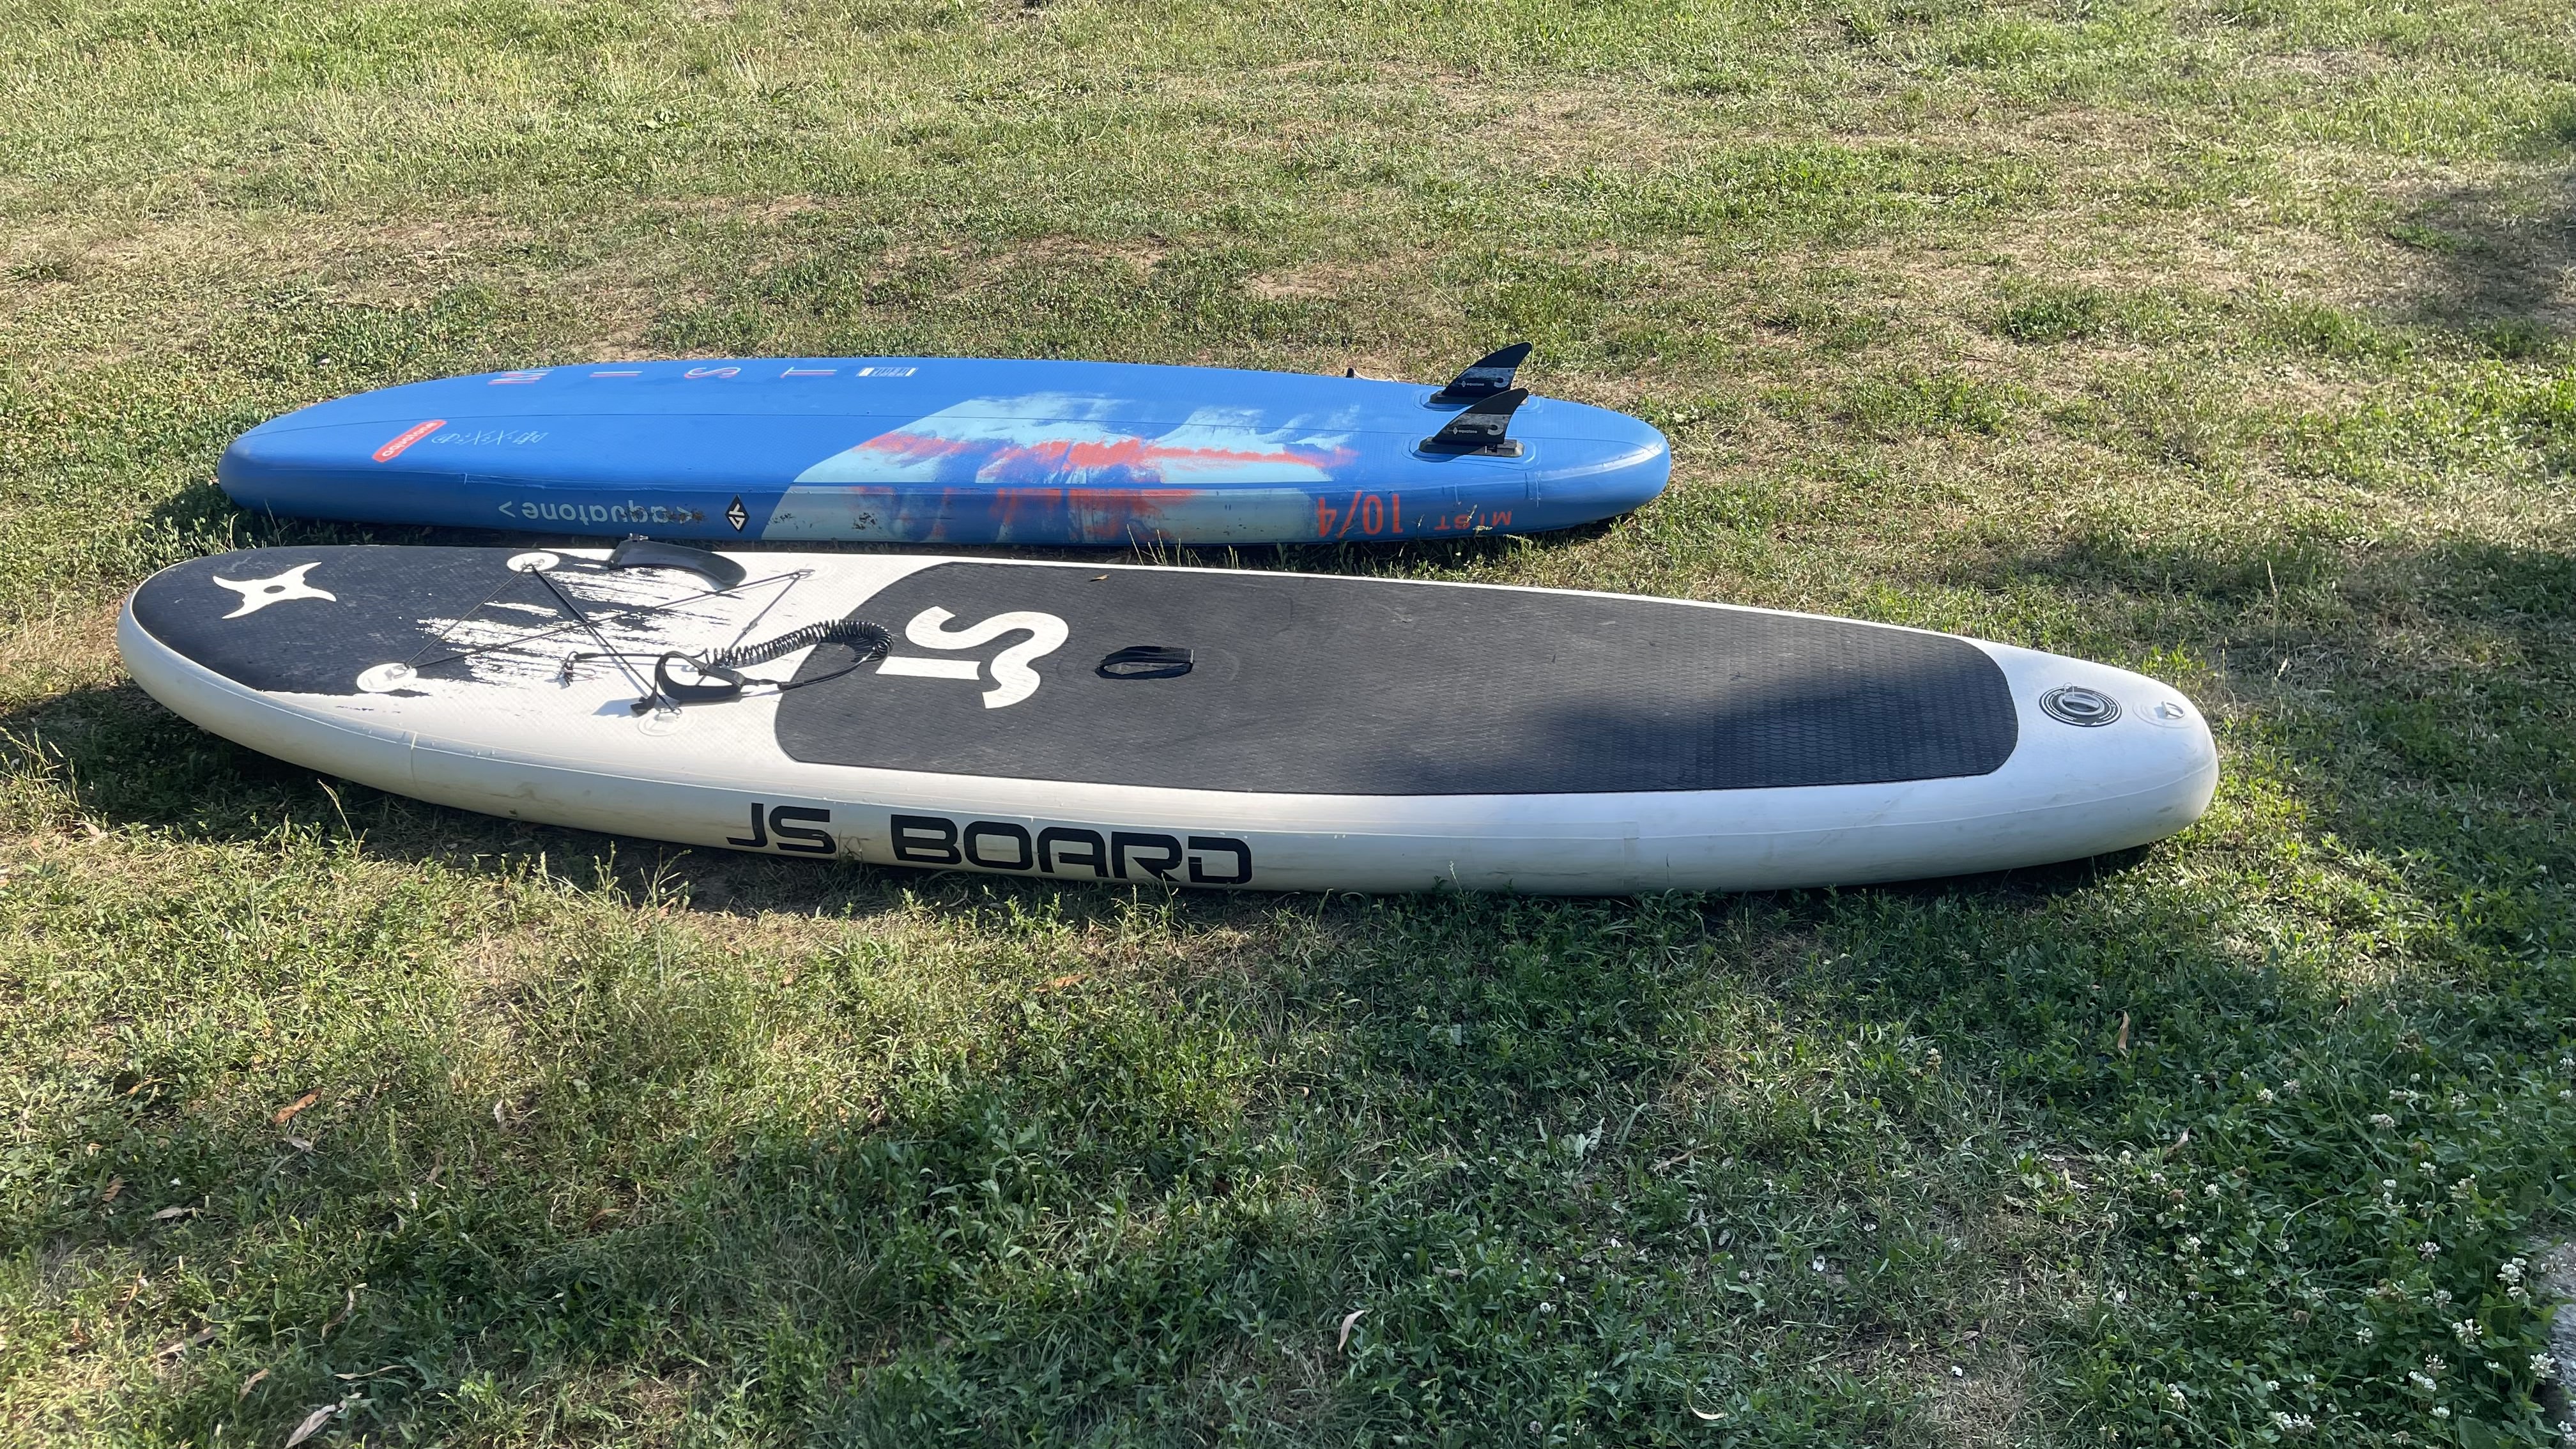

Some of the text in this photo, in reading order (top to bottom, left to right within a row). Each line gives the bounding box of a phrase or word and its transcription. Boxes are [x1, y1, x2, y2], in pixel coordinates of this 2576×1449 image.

[1317, 490, 1404, 539] 10/4
[726, 802, 1253, 885] JS BOARD
